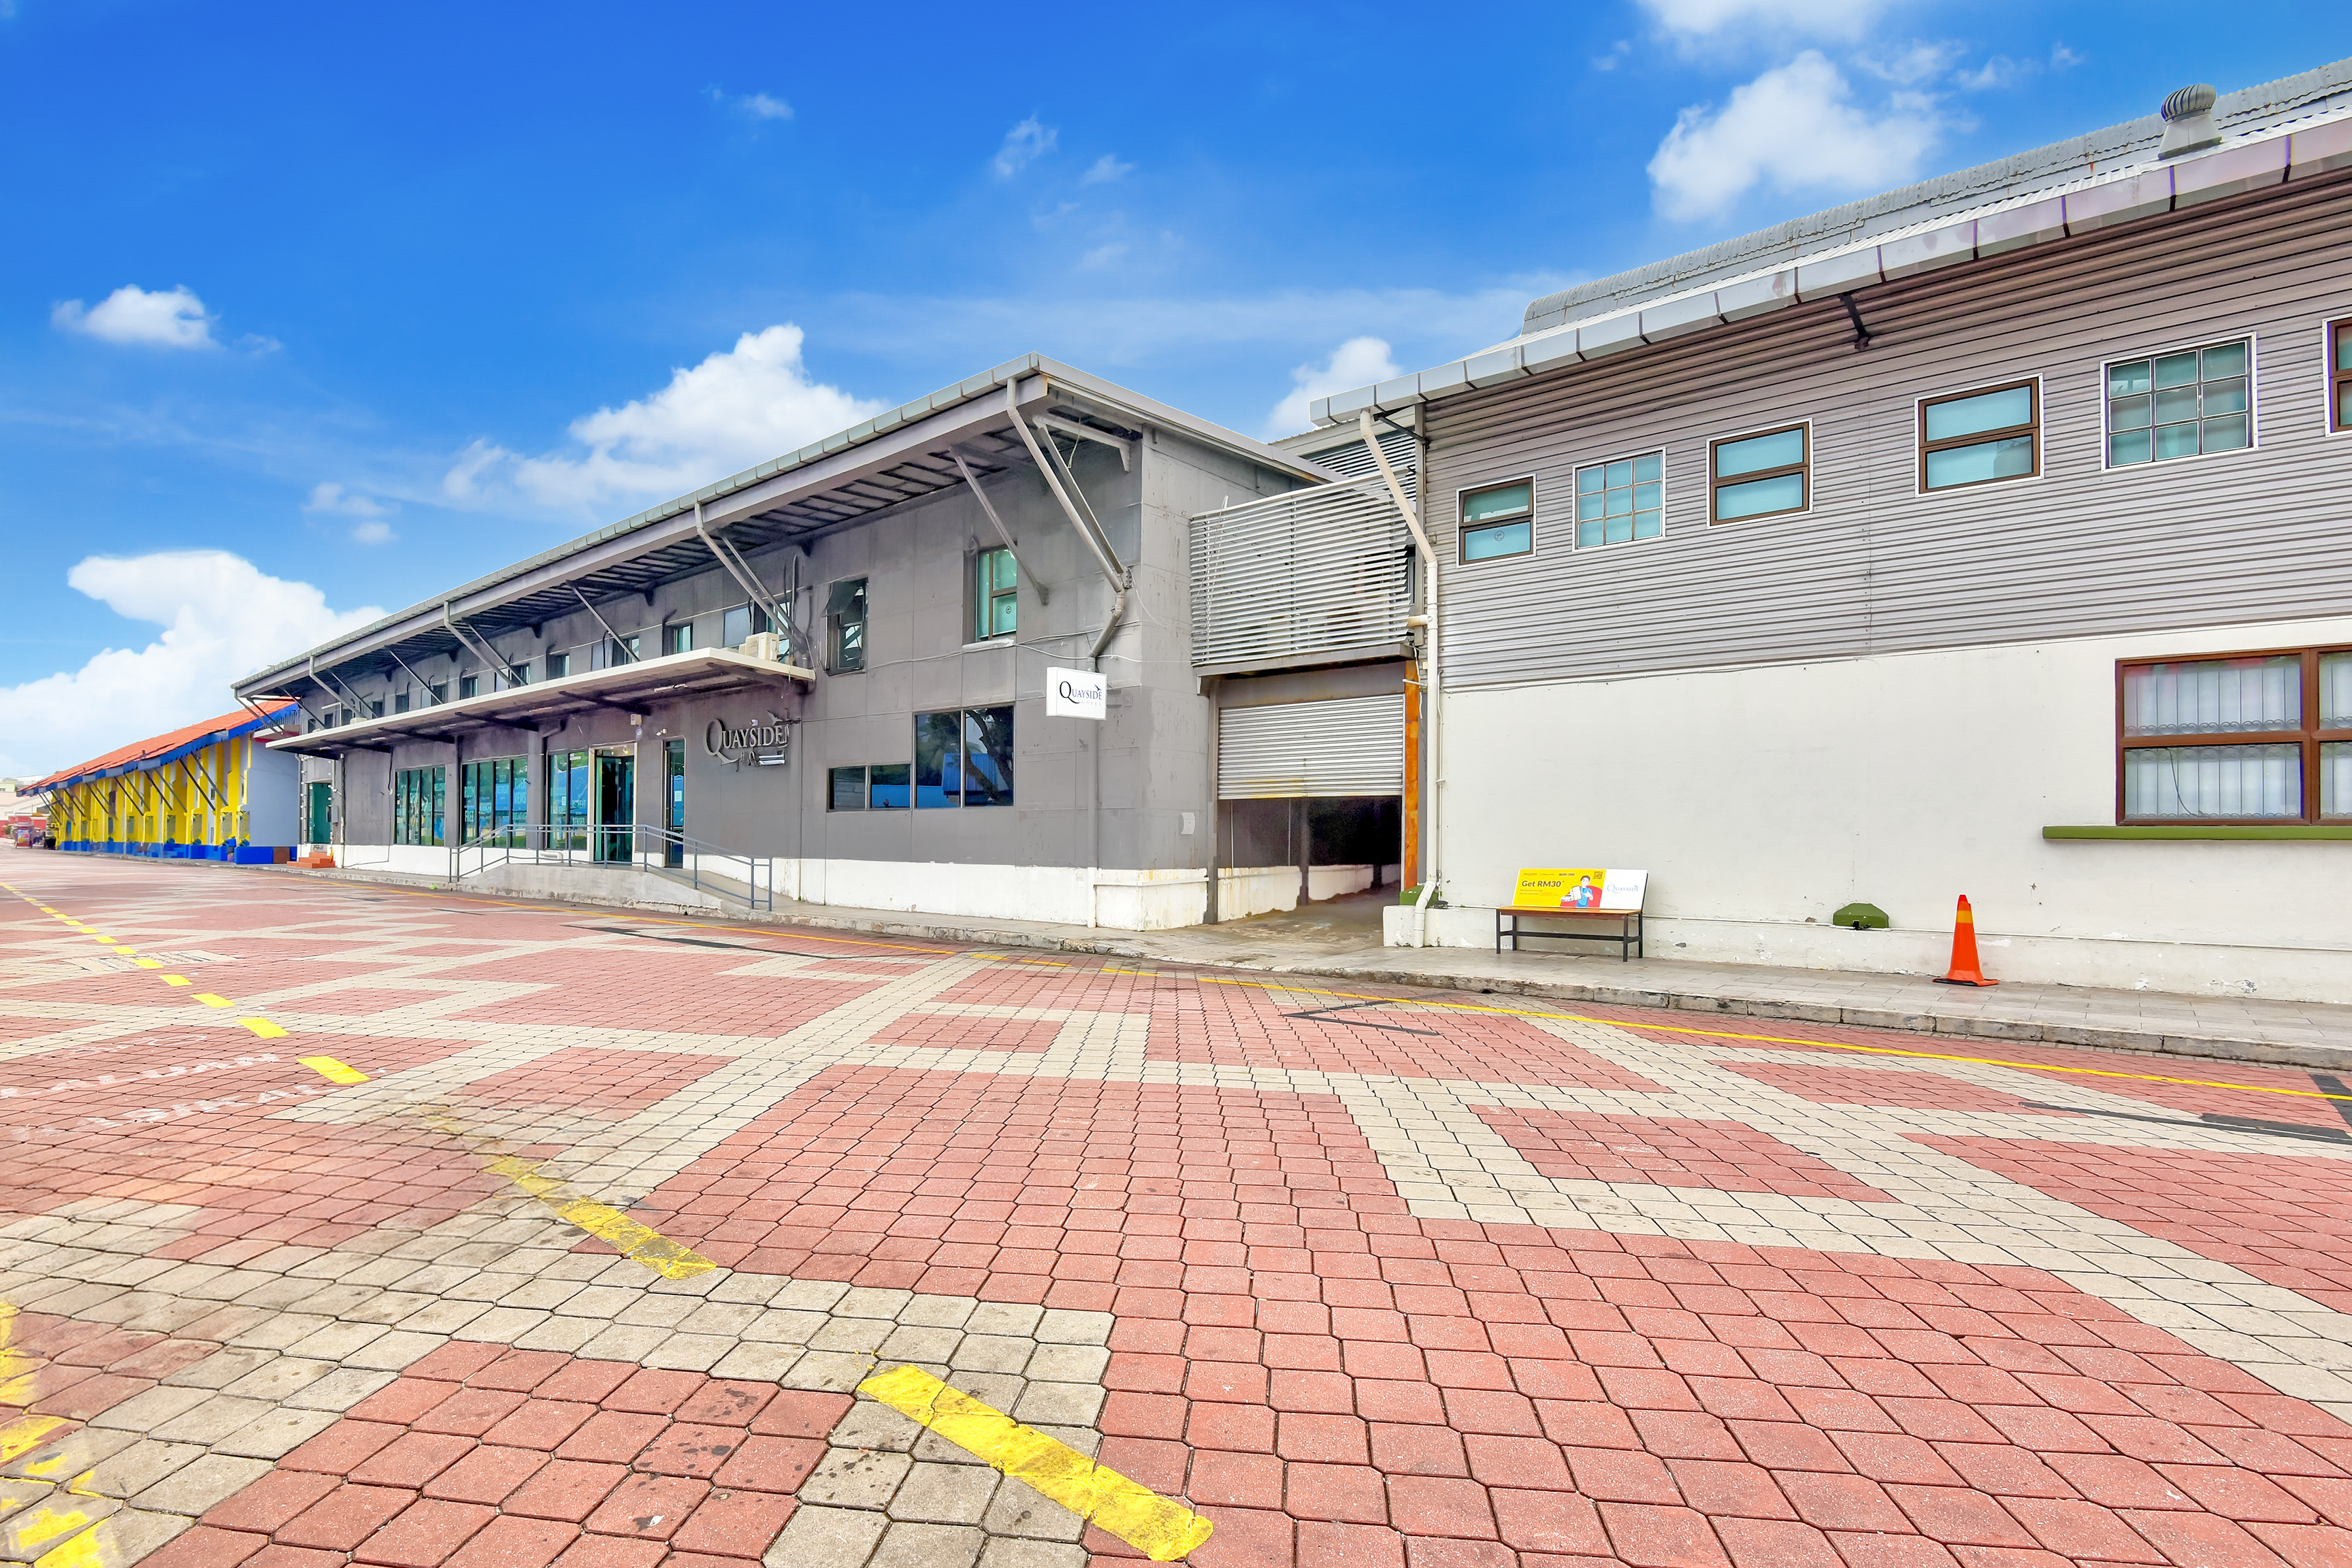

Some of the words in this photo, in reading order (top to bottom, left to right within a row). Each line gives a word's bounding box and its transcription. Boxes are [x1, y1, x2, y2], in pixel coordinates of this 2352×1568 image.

[1060, 681, 1102, 704] QUAYSIDE
[703, 718, 787, 764] QUAYSIDE
[464, 785, 476, 798] ROOM
[465, 810, 474, 823] FREE
